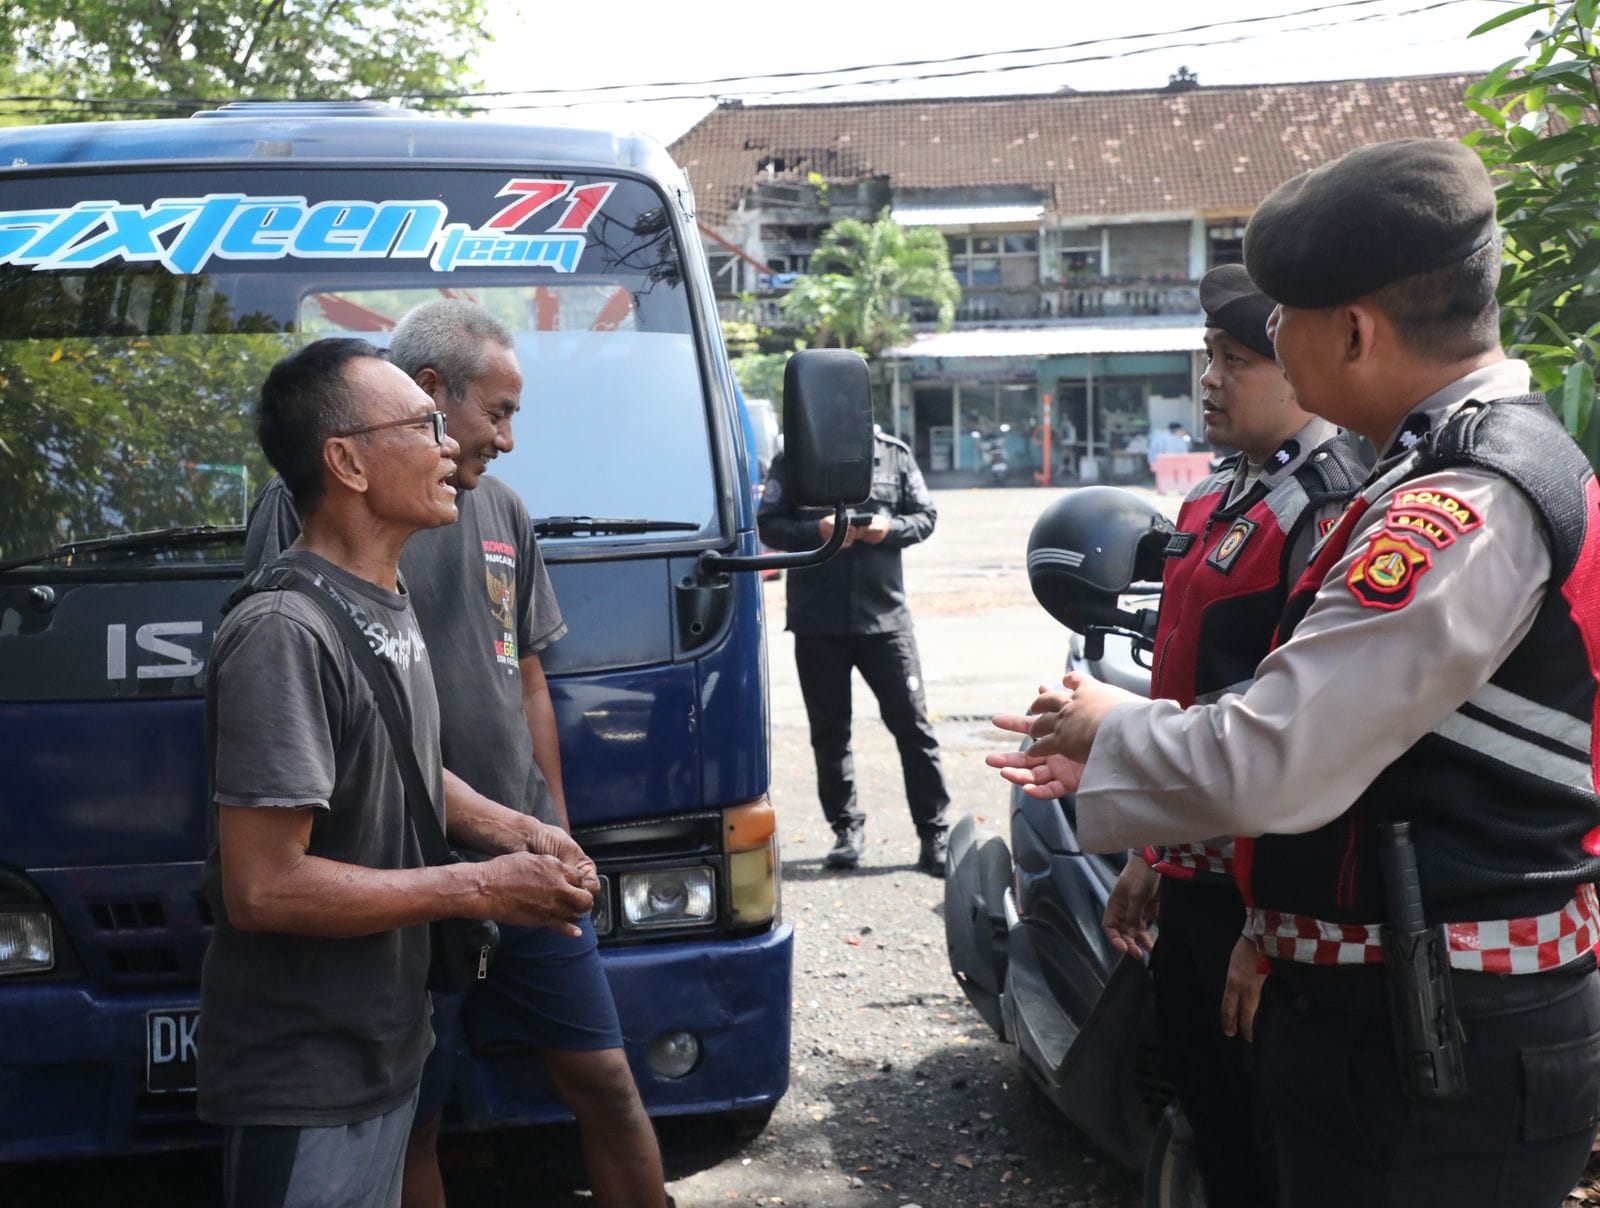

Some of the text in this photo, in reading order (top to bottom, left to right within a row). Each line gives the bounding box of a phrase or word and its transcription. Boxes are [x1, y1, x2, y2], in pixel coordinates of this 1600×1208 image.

[476, 178, 618, 233] 71
[1397, 515, 1443, 538] BALI
[1401, 491, 1470, 524] POLDA
[153, 1014, 201, 1064] DK
